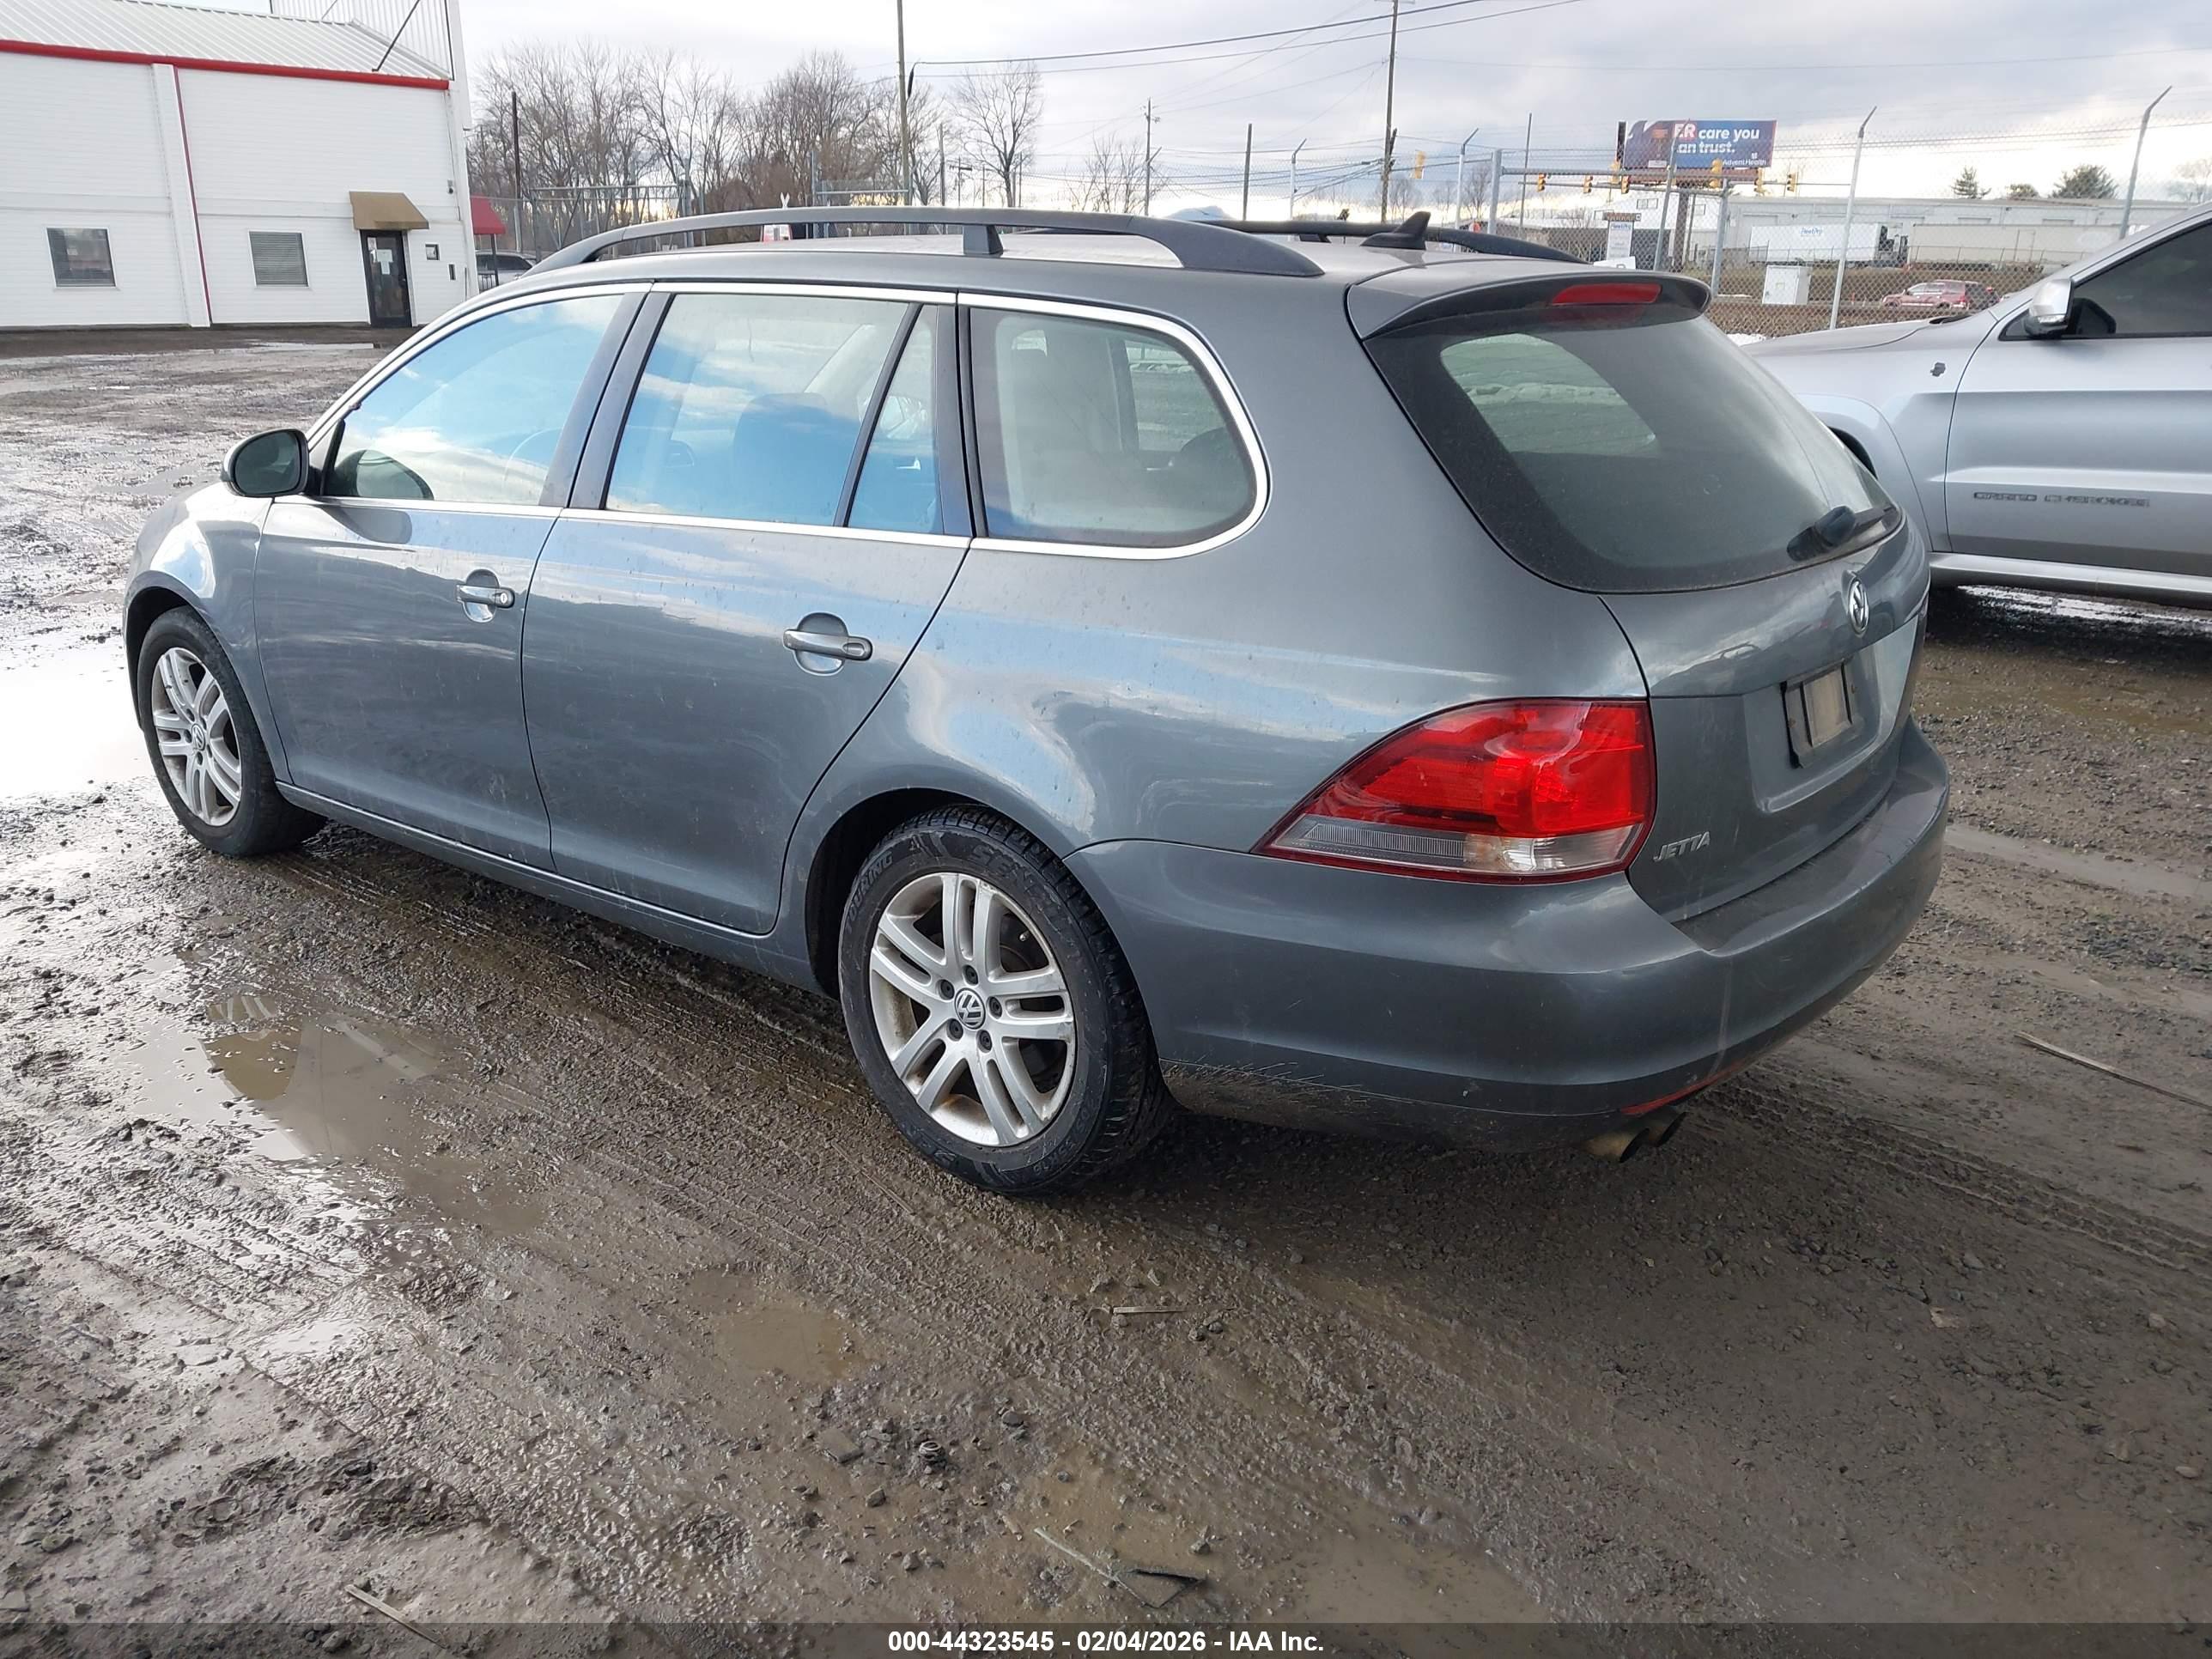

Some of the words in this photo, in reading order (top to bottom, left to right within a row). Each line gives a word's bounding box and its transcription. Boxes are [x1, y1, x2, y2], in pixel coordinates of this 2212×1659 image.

[1674, 123, 1696, 138] ER
[1698, 129, 1730, 139] care
[1733, 129, 1760, 143] you
[1677, 143, 1697, 154] an
[1698, 141, 1735, 154] trust.
[1653, 830, 1711, 863] JETTA
